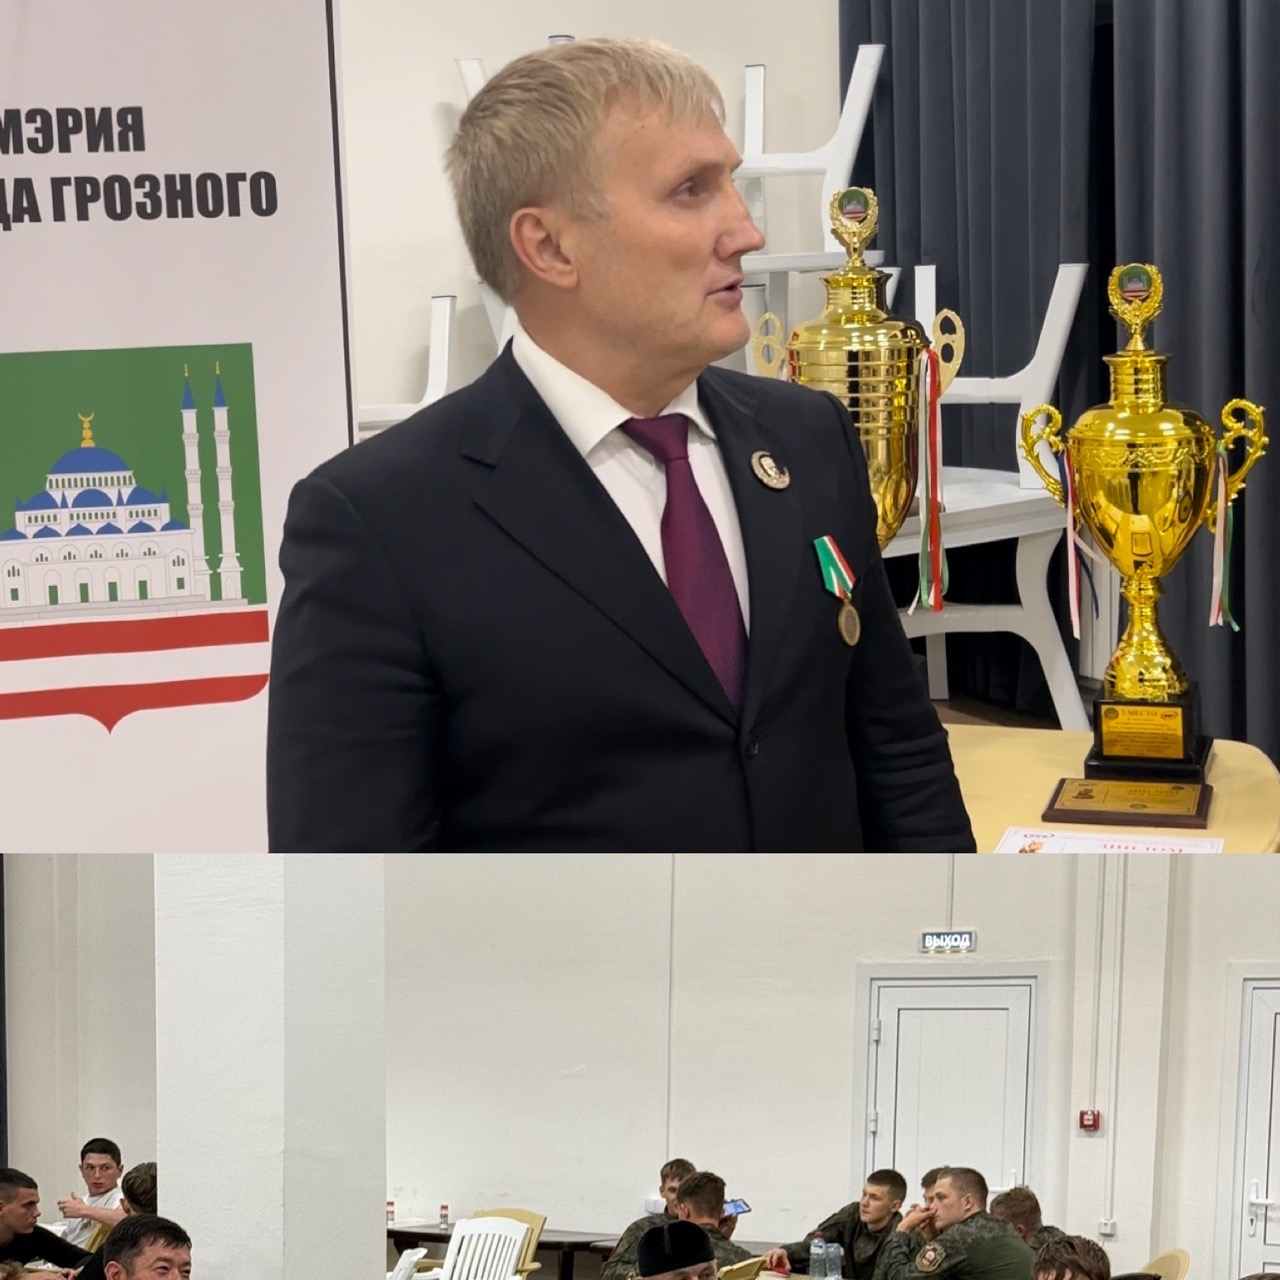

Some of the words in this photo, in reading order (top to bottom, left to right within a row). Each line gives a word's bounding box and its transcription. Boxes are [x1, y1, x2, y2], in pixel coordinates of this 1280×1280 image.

[0, 106, 146, 154] МЭРИЯ
[50, 171, 278, 222] ГРОЗНОГО
[925, 934, 971, 949] ВЫХОД
